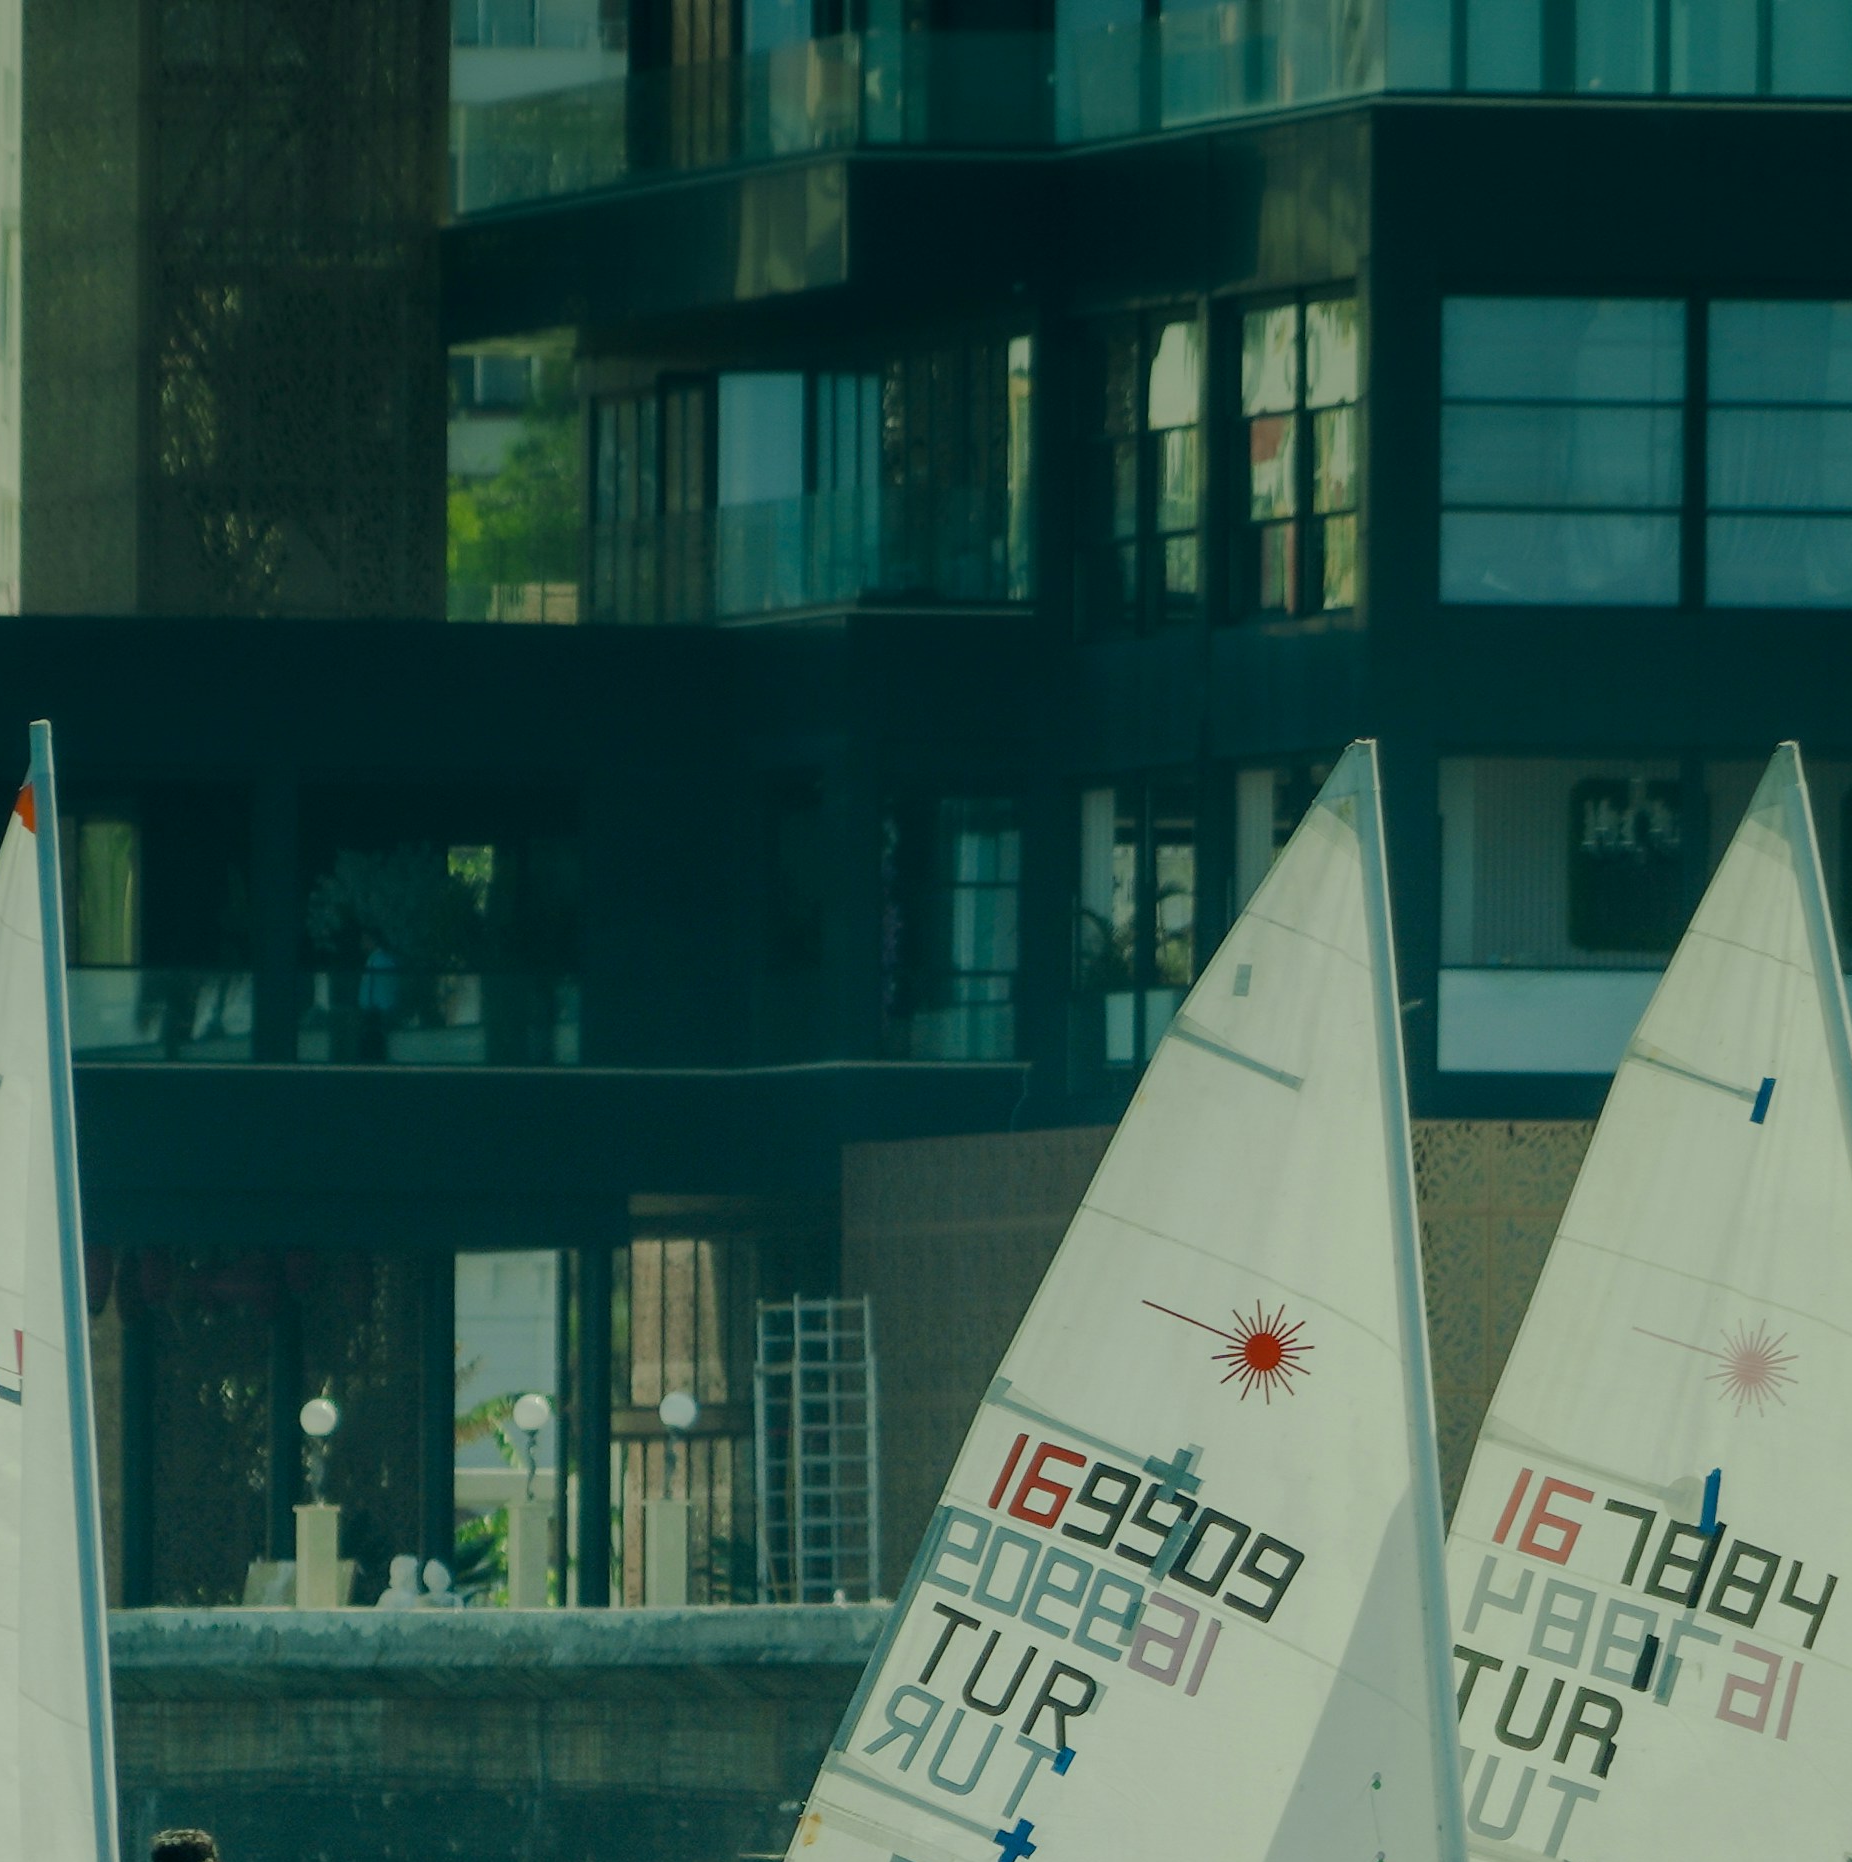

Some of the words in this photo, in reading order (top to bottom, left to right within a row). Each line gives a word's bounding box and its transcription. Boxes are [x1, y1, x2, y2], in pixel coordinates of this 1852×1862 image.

[988, 1433, 1305, 1624] 169909
[1492, 1467, 1839, 1650] 167884
[918, 1602, 1098, 1751] TUR
[1453, 1644, 1623, 1780] TUR
